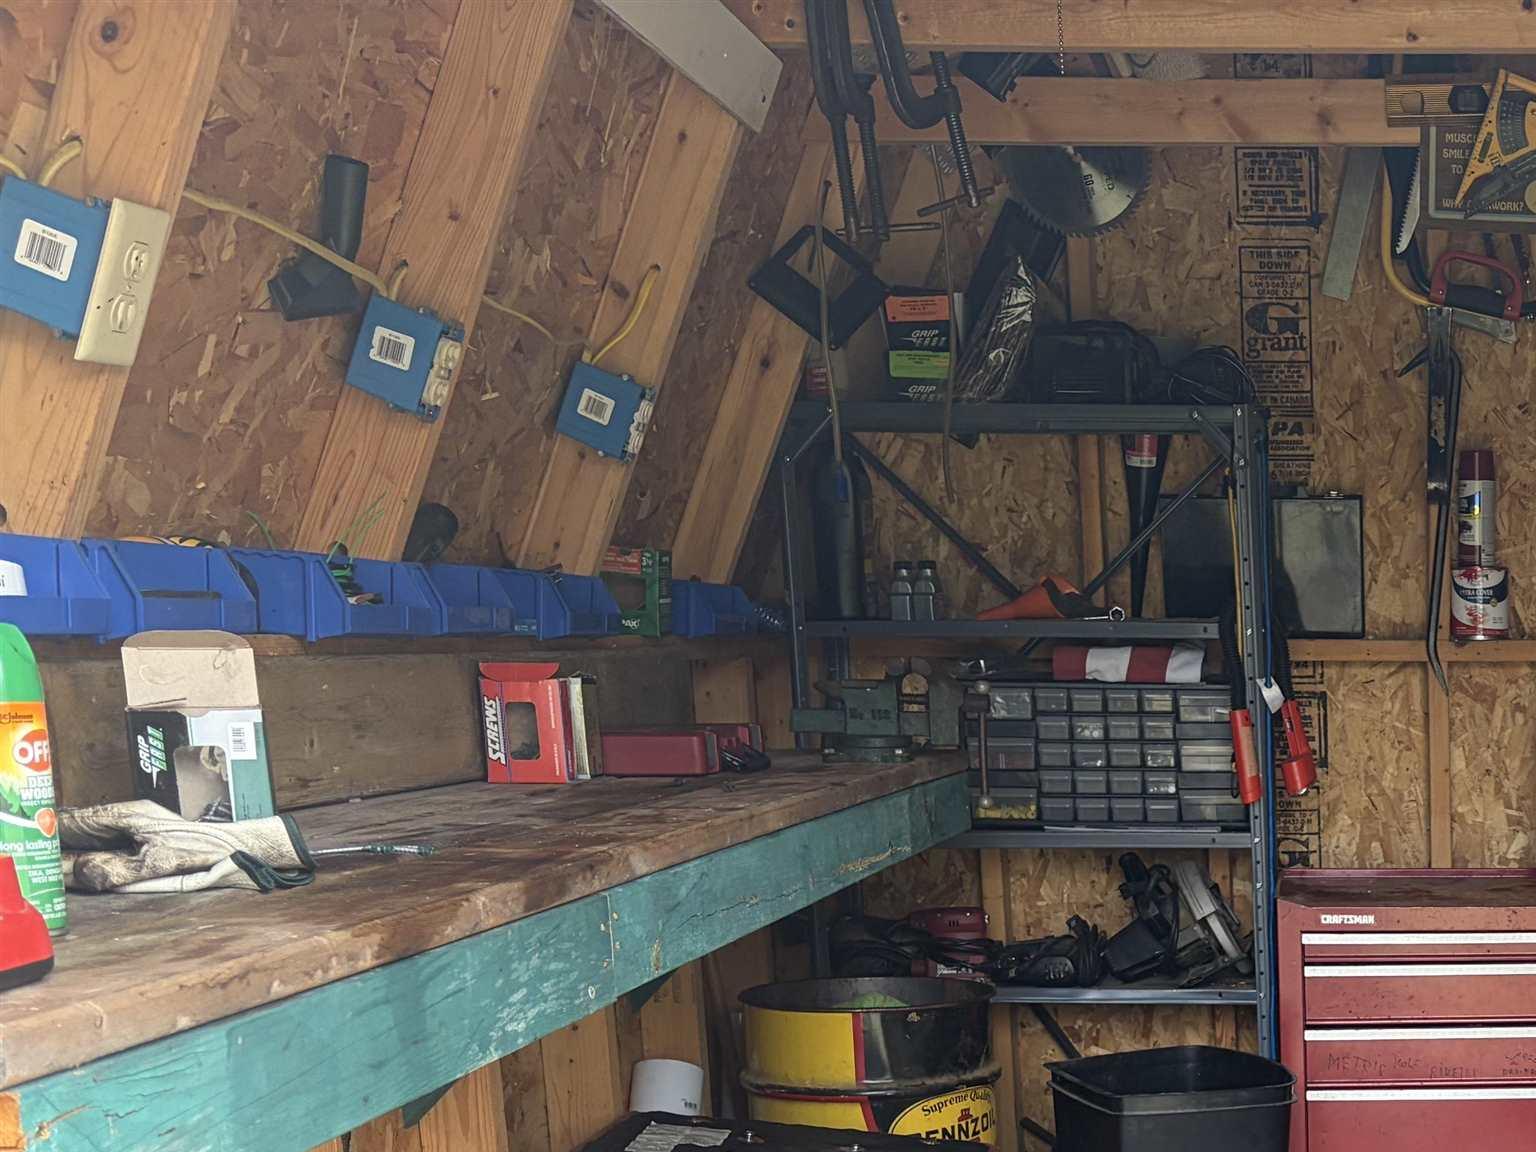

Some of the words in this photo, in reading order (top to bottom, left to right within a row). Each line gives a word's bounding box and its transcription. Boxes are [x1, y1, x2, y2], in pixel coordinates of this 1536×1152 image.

[1452, 165, 1463, 174] TO
[1249, 250, 1273, 259] THIS
[1259, 261, 1291, 270] DOWN
[912, 329, 938, 338] GRIP
[1246, 332, 1308, 359] grant
[1272, 421, 1304, 436] PA
[483, 695, 502, 762] SCREWS
[137, 734, 151, 773] GRIP
[1279, 801, 1302, 809] OWN
[1321, 914, 1375, 925] CRAFTSMAN
[922, 1093, 969, 1117] Supreme
[912, 1107, 996, 1143] ENNZOIL
